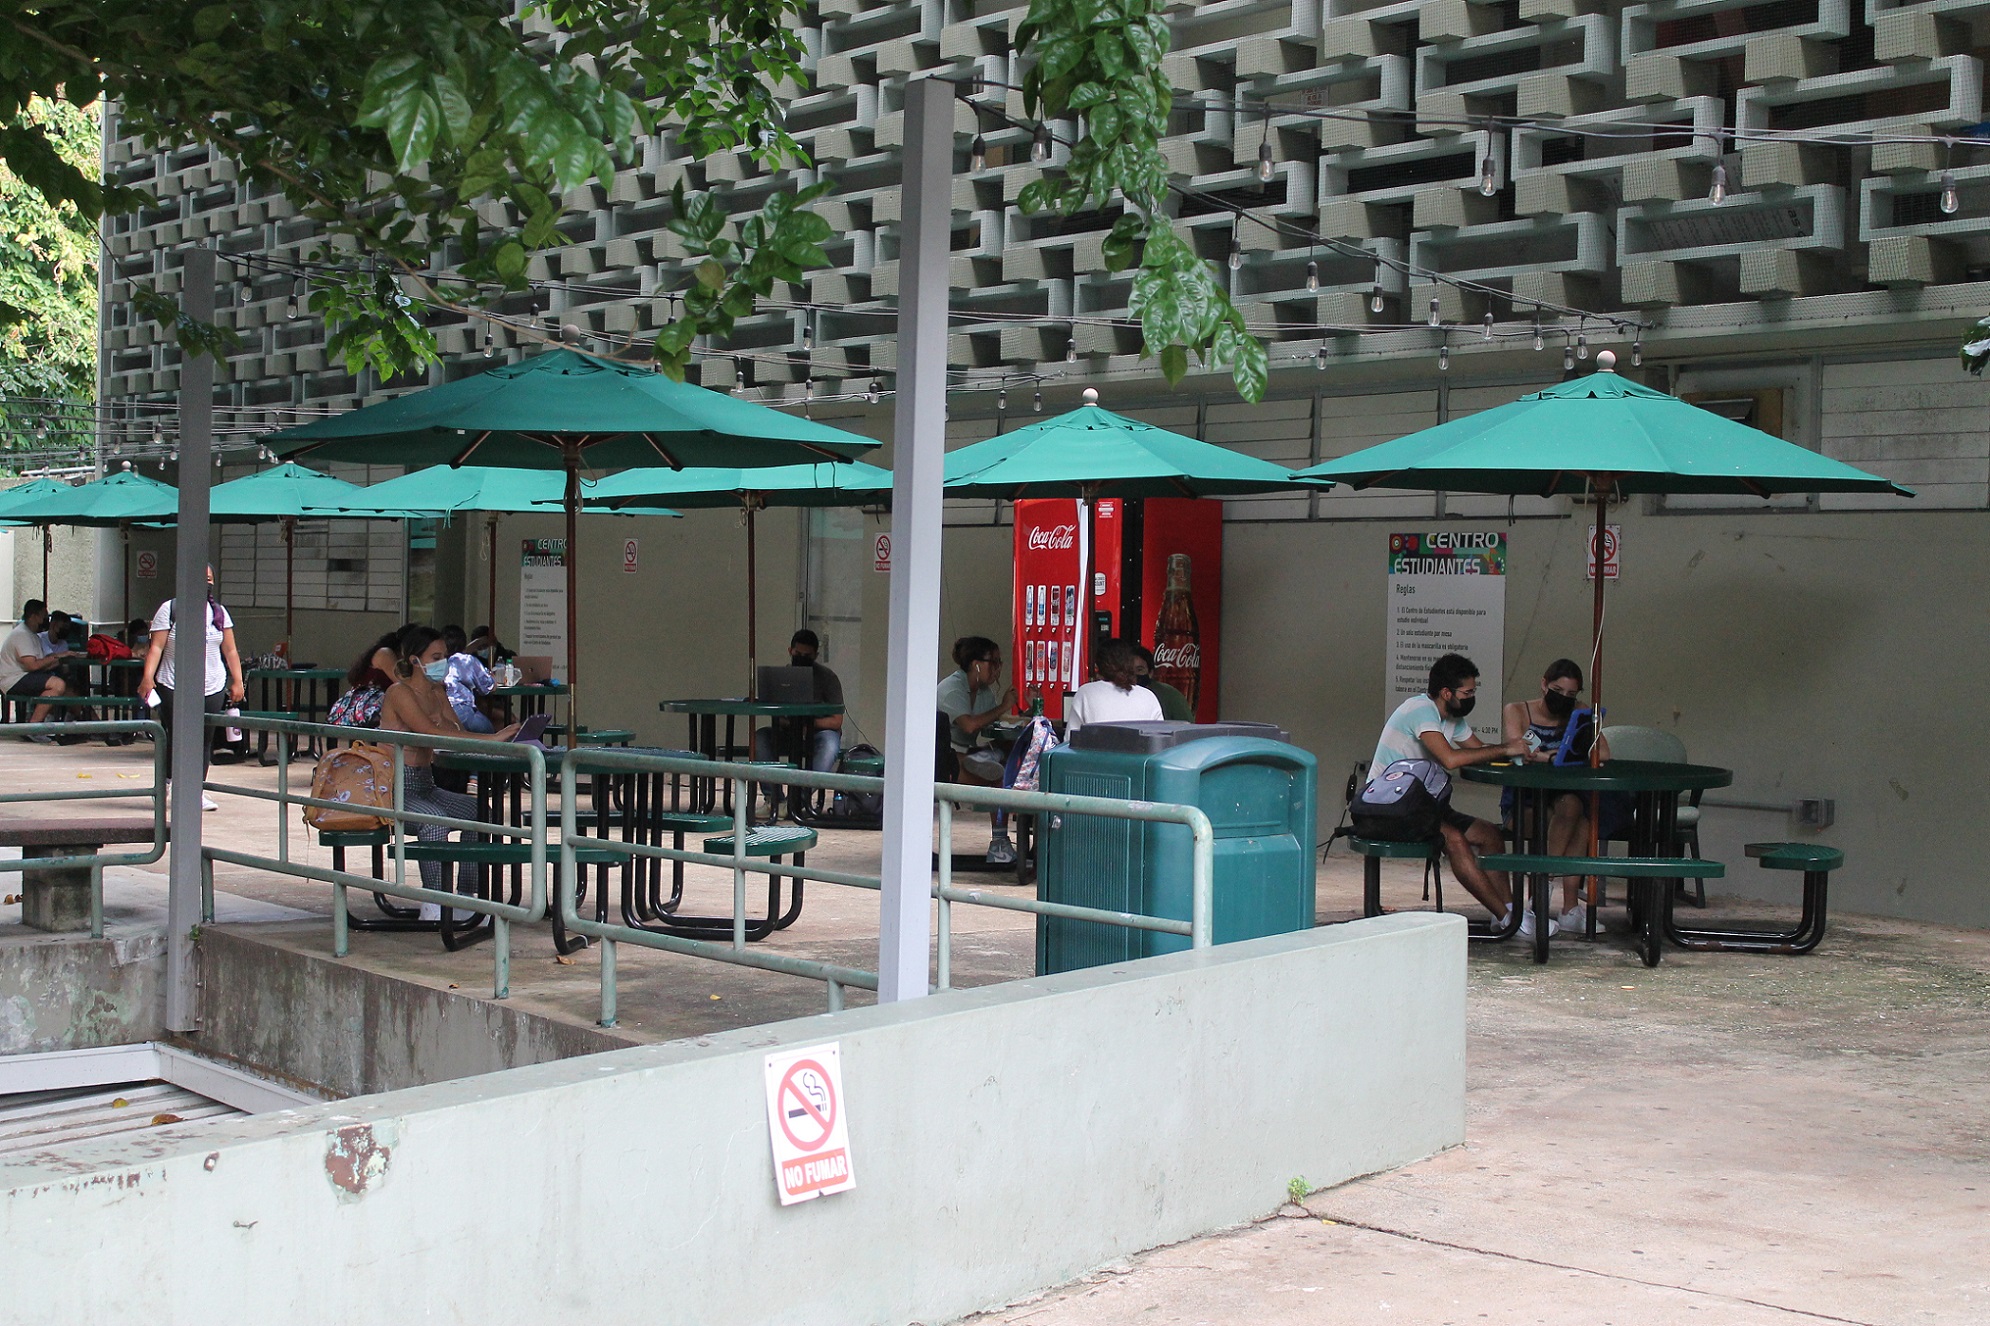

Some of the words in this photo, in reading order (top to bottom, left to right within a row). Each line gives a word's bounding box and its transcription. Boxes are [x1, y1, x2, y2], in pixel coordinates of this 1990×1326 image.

[1028, 524, 1076, 550] Coca-Cola
[1426, 532, 1498, 548] CENTRO
[1394, 558, 1480, 574] ESTUDIANTES
[1396, 584, 1416, 596] Reglas
[1154, 642, 1200, 668] Coca-Cola
[784, 1165, 804, 1189] NO
[804, 1154, 848, 1184] FUMAR
